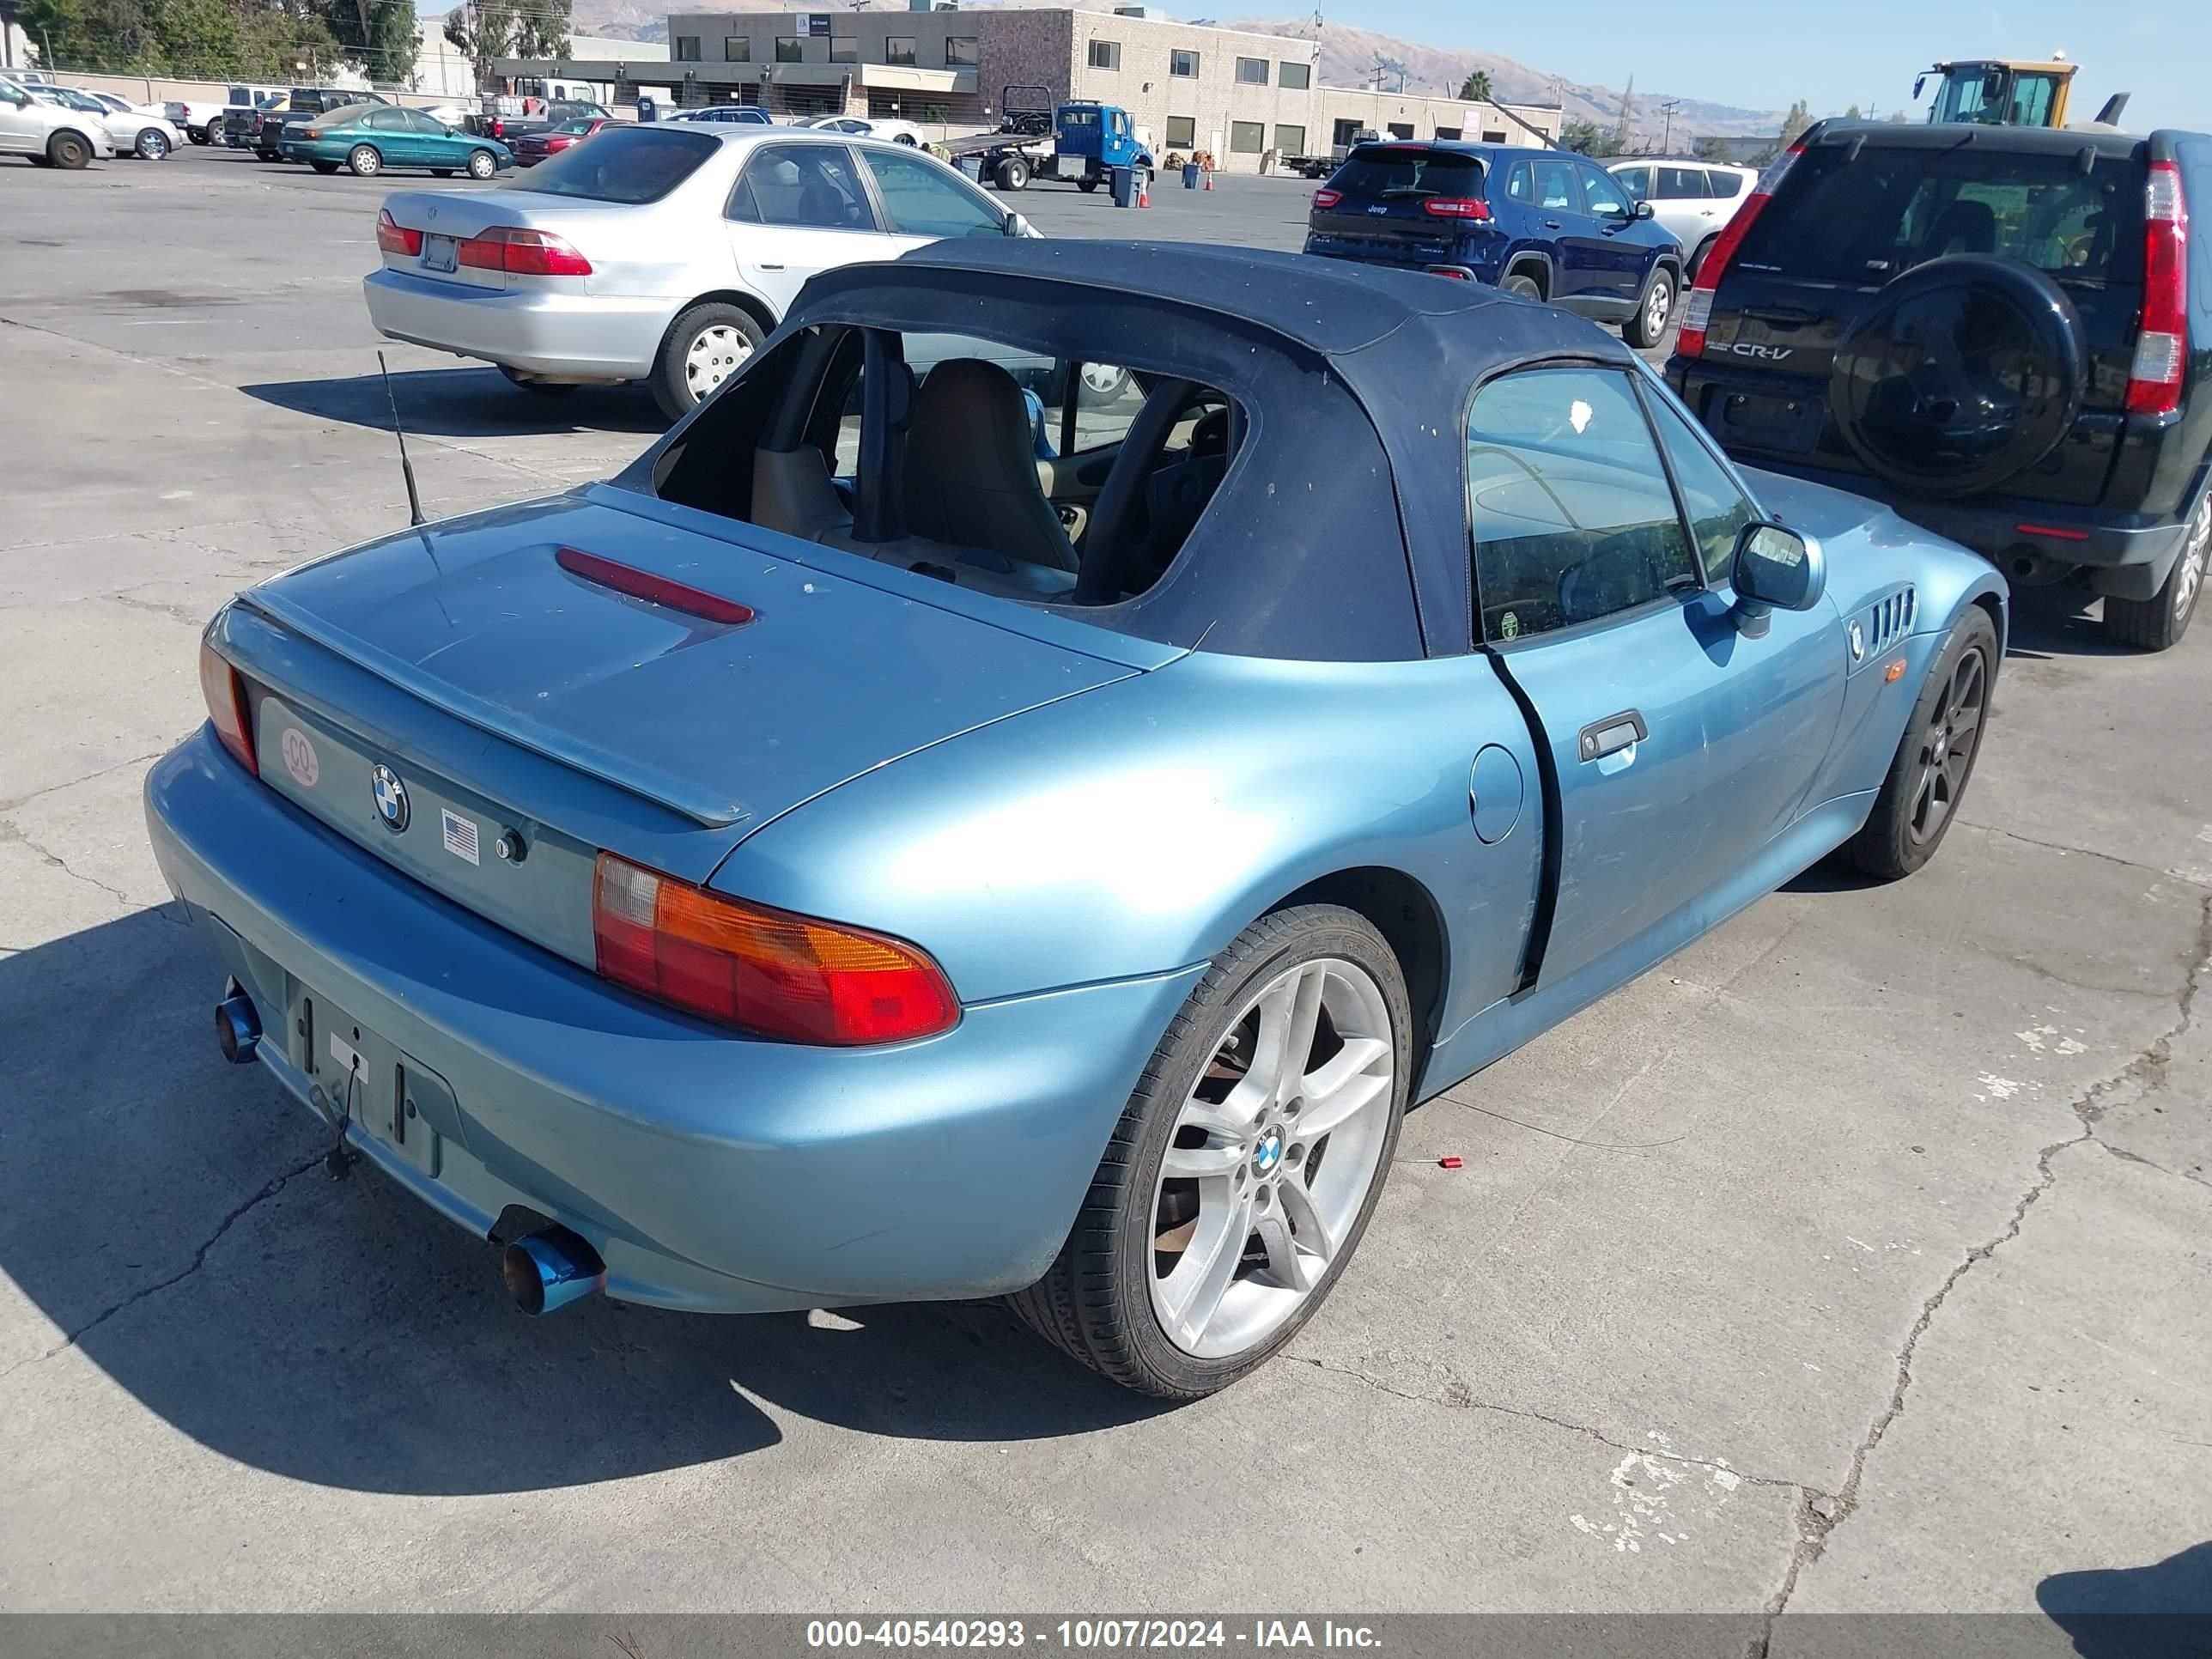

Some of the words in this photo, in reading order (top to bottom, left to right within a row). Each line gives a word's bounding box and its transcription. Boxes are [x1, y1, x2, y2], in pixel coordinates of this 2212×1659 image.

[1368, 204, 1388, 215] Jeep
[1733, 343, 1794, 360] CR-V
[373, 767, 402, 794] BMW
[1252, 1126, 1278, 1162] BMW
